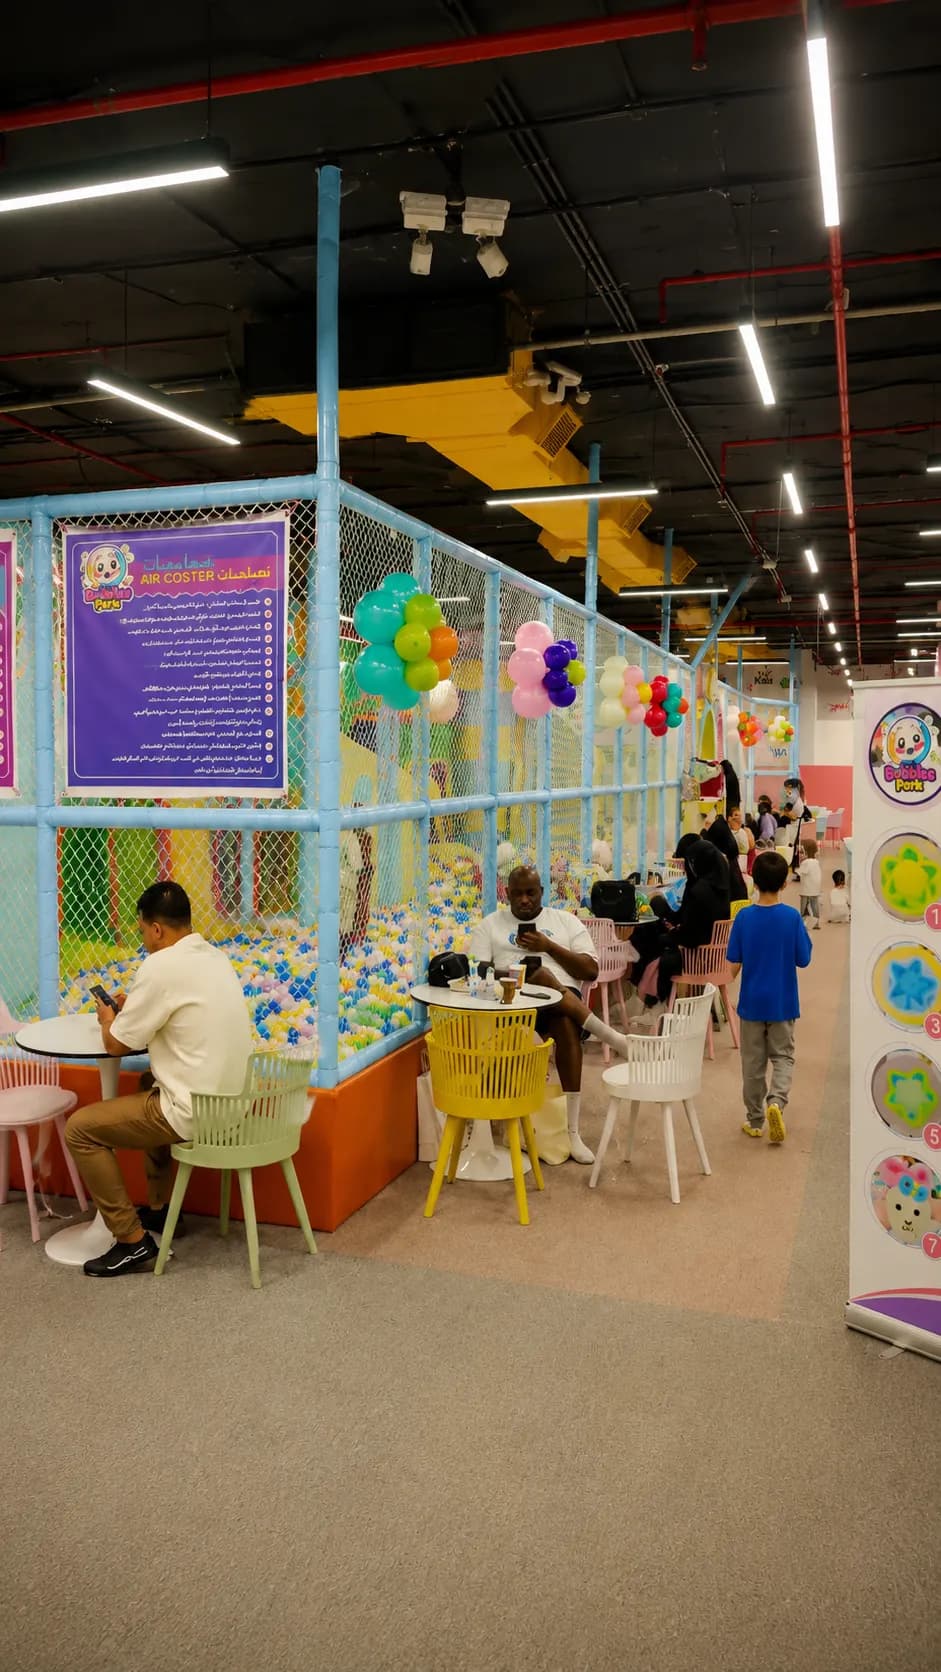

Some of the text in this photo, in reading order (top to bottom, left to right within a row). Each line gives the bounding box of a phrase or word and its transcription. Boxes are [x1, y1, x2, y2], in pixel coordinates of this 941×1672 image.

[140, 570, 214, 584] AIR COSTER
[931, 908, 938, 925] 1
[931, 1018, 940, 1034] 3
[930, 1128, 939, 1145] 5
[928, 1238, 937, 1254] 7
